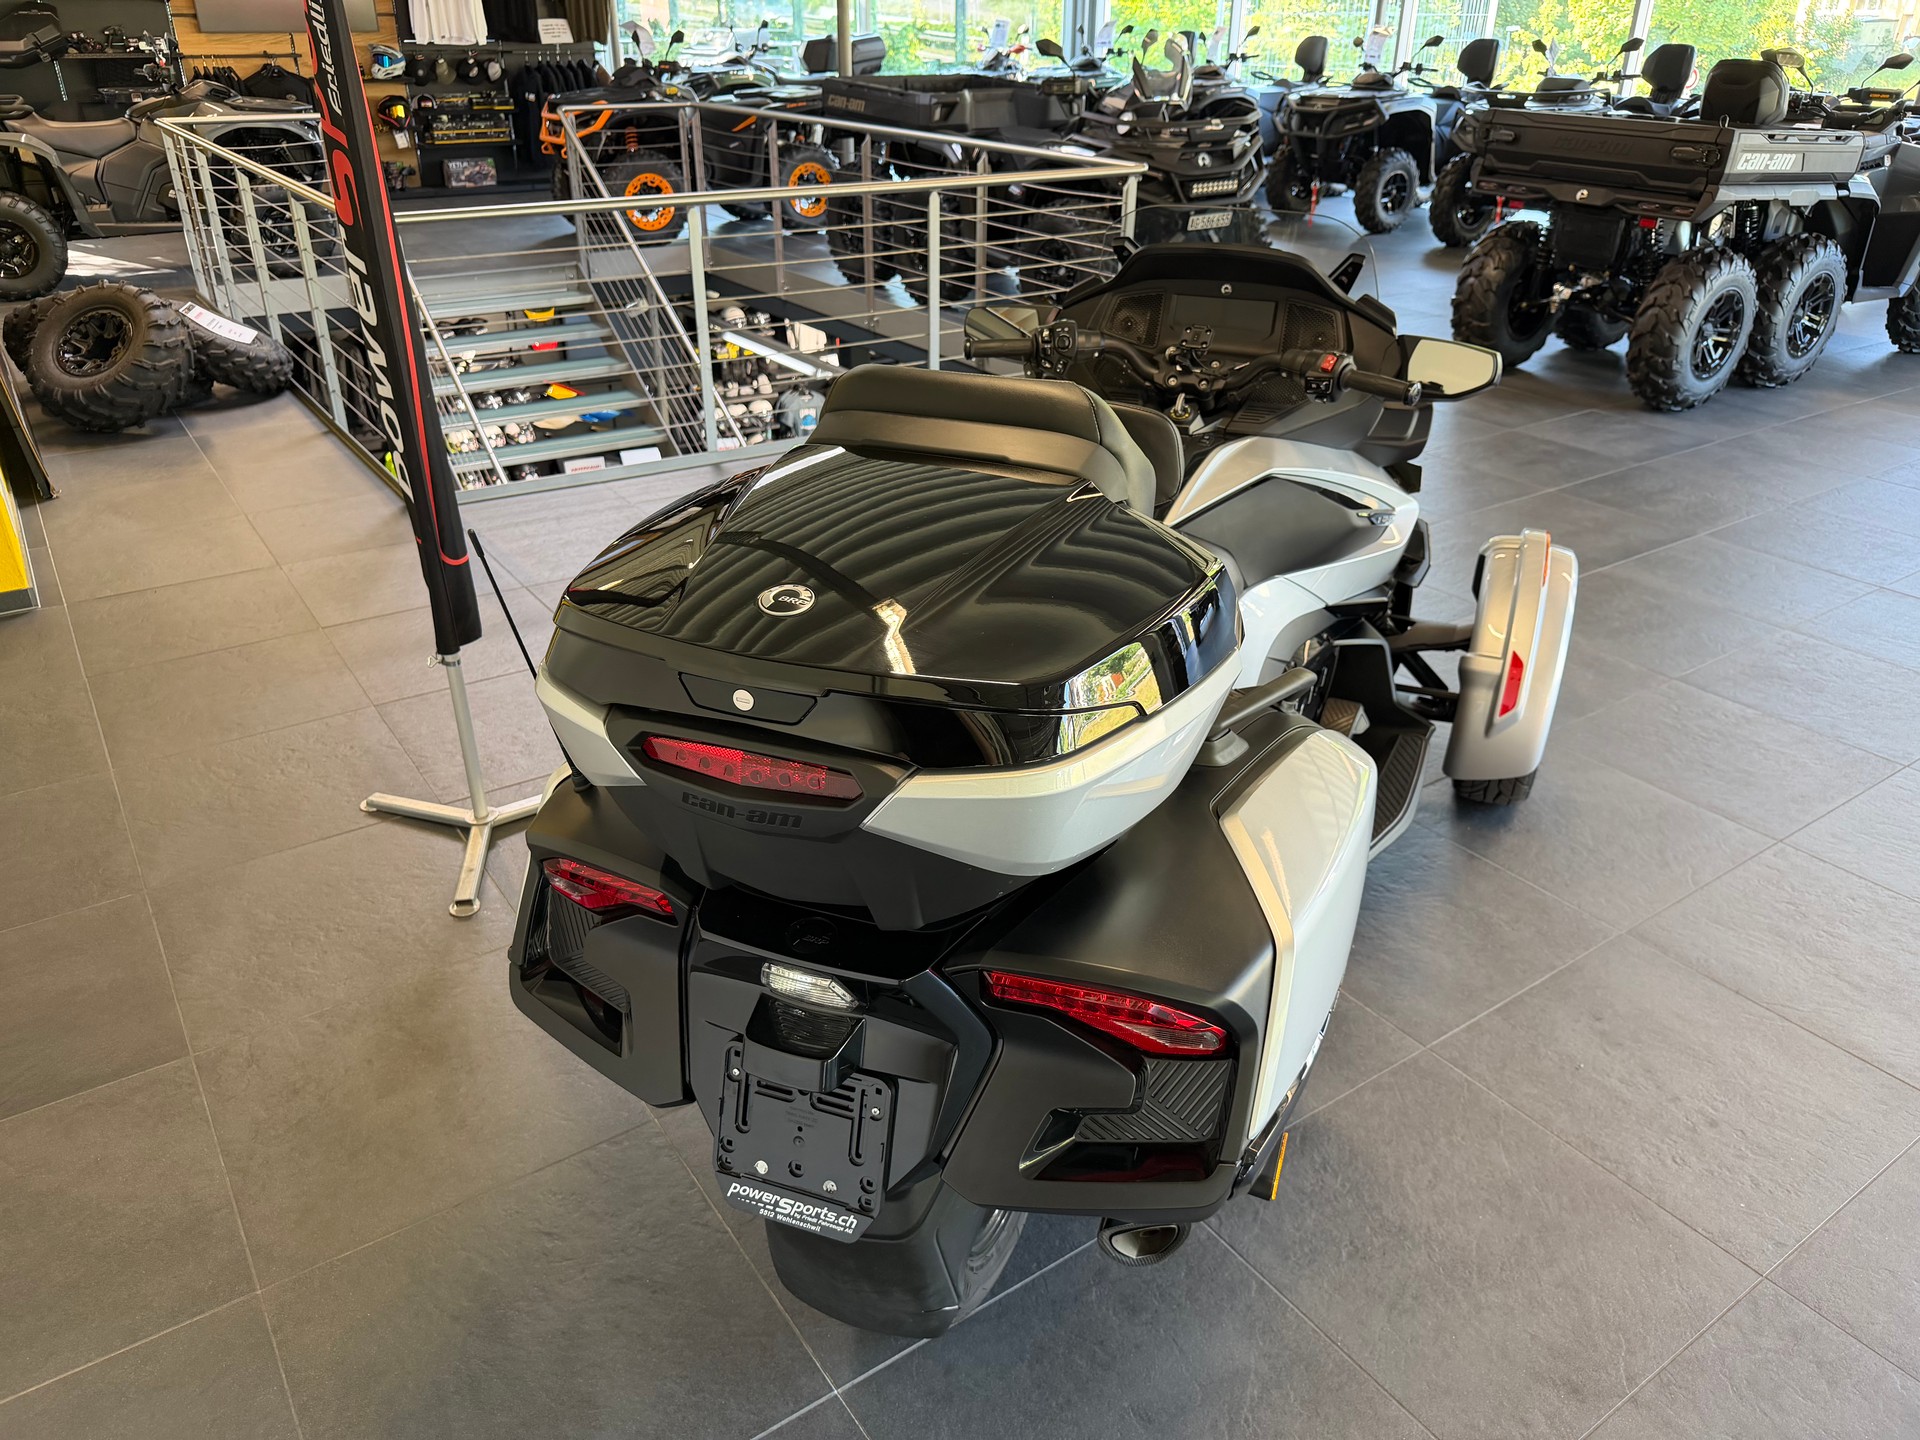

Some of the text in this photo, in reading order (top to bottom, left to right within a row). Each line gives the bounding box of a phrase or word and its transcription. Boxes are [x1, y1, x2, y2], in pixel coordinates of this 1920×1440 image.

[826, 94, 867, 112] can-am
[1736, 152, 1797, 171] can-am
[681, 790, 804, 830] can-am
[726, 1182, 858, 1229] powerSports.ch
[759, 1208, 822, 1232] 5512 Wohlenschwil
